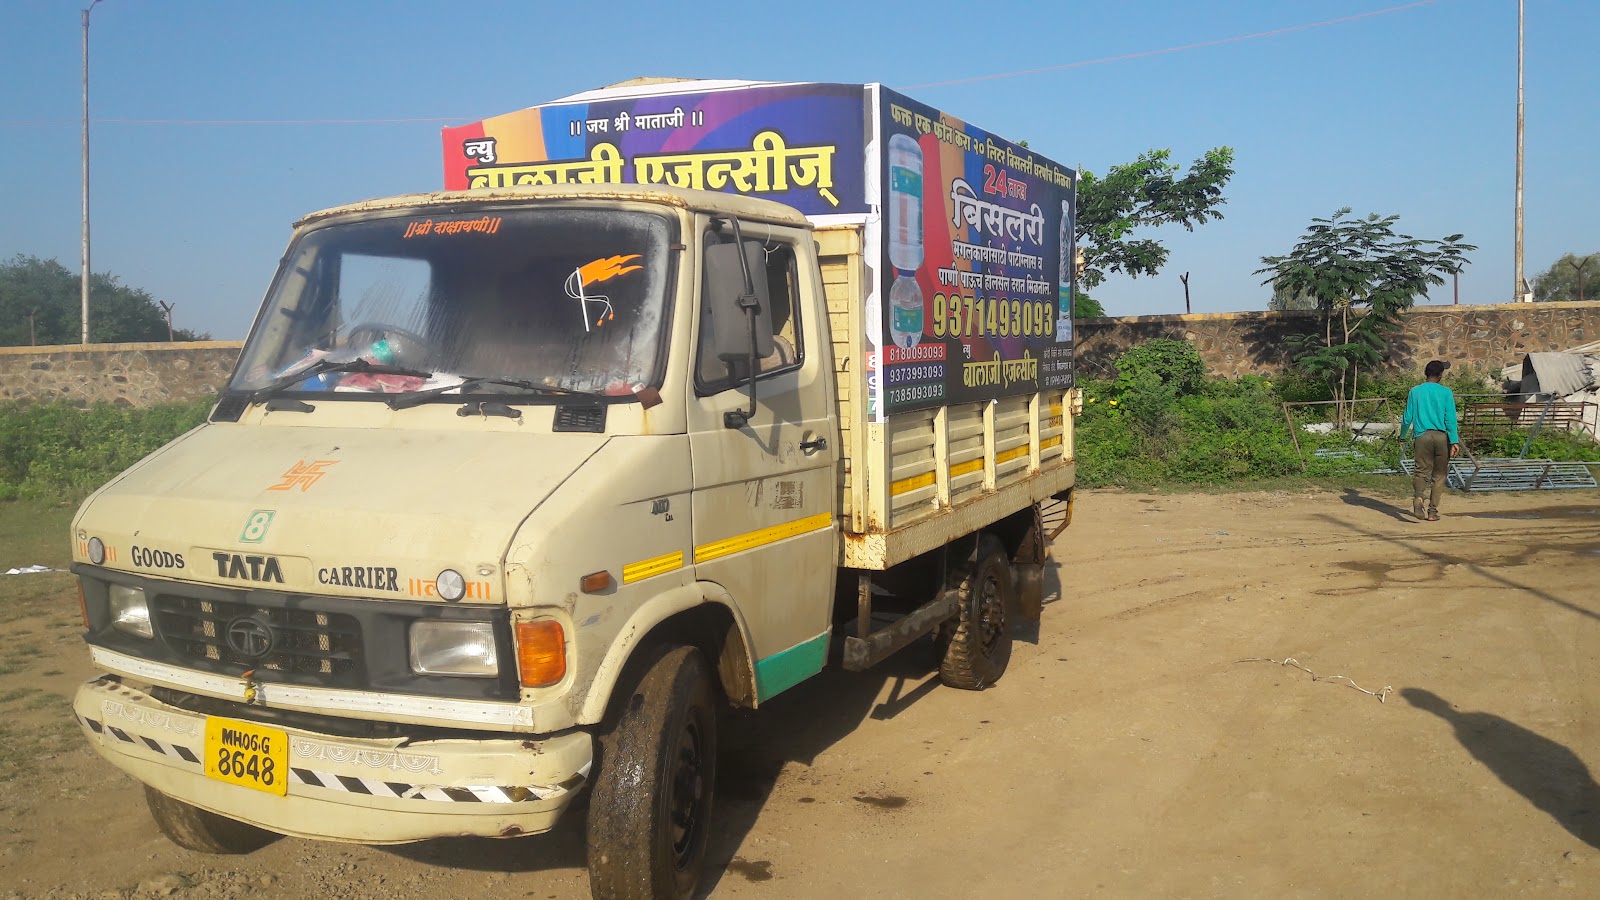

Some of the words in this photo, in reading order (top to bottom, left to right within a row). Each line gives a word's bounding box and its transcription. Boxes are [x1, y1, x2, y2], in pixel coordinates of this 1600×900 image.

[586, 118, 609, 133] जय
[614, 111, 630, 132] श्री
[635, 107, 685, 131] माताजी
[890, 103, 912, 127] फक्त
[914, 113, 932, 135] एक
[933, 117, 953, 144] फोन
[954, 129, 971, 151] करा
[986, 137, 1005, 164] लिटर
[465, 140, 495, 163] न्यु
[983, 164, 1007, 198] 24
[951, 177, 1045, 246] बिसलरी
[938, 261, 958, 287] पाणी
[932, 292, 1054, 339] 9371493093
[889, 345, 944, 363] 8180093093
[889, 365, 944, 384] 9373993093
[962, 351, 1001, 387] बालाजी
[889, 389, 944, 406] 7385093093
[131, 545, 185, 569] GOODS
[213, 552, 285, 584] TATA
[317, 566, 399, 592] CARRIER
[218, 748, 275, 786] 8648
